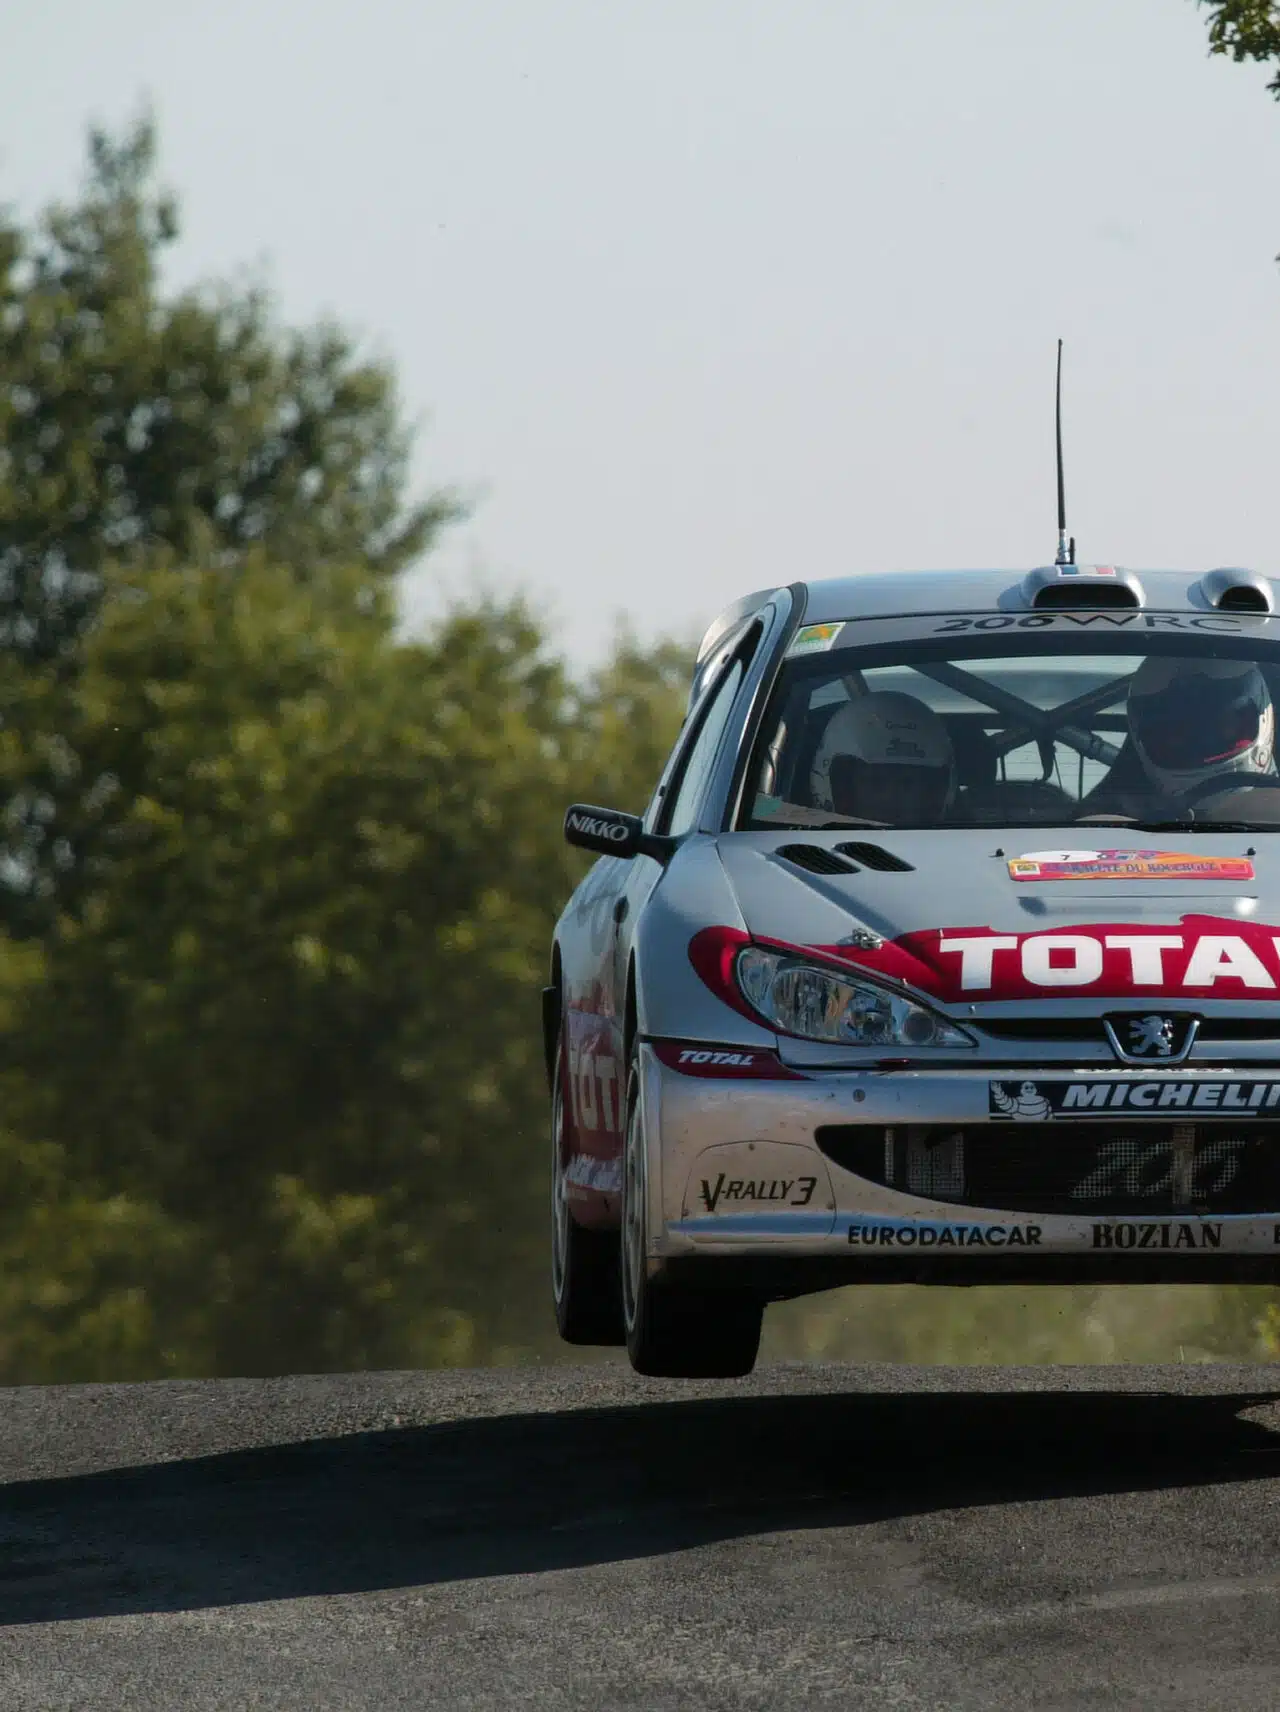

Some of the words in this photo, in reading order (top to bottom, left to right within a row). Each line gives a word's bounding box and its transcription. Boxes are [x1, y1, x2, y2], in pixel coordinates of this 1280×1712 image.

[566, 812, 629, 842] NIKKO
[678, 1050, 754, 1066] TOTAL
[847, 1224, 1043, 1247] EURODATACAR
[1092, 1221, 1224, 1249] BOZIAN
